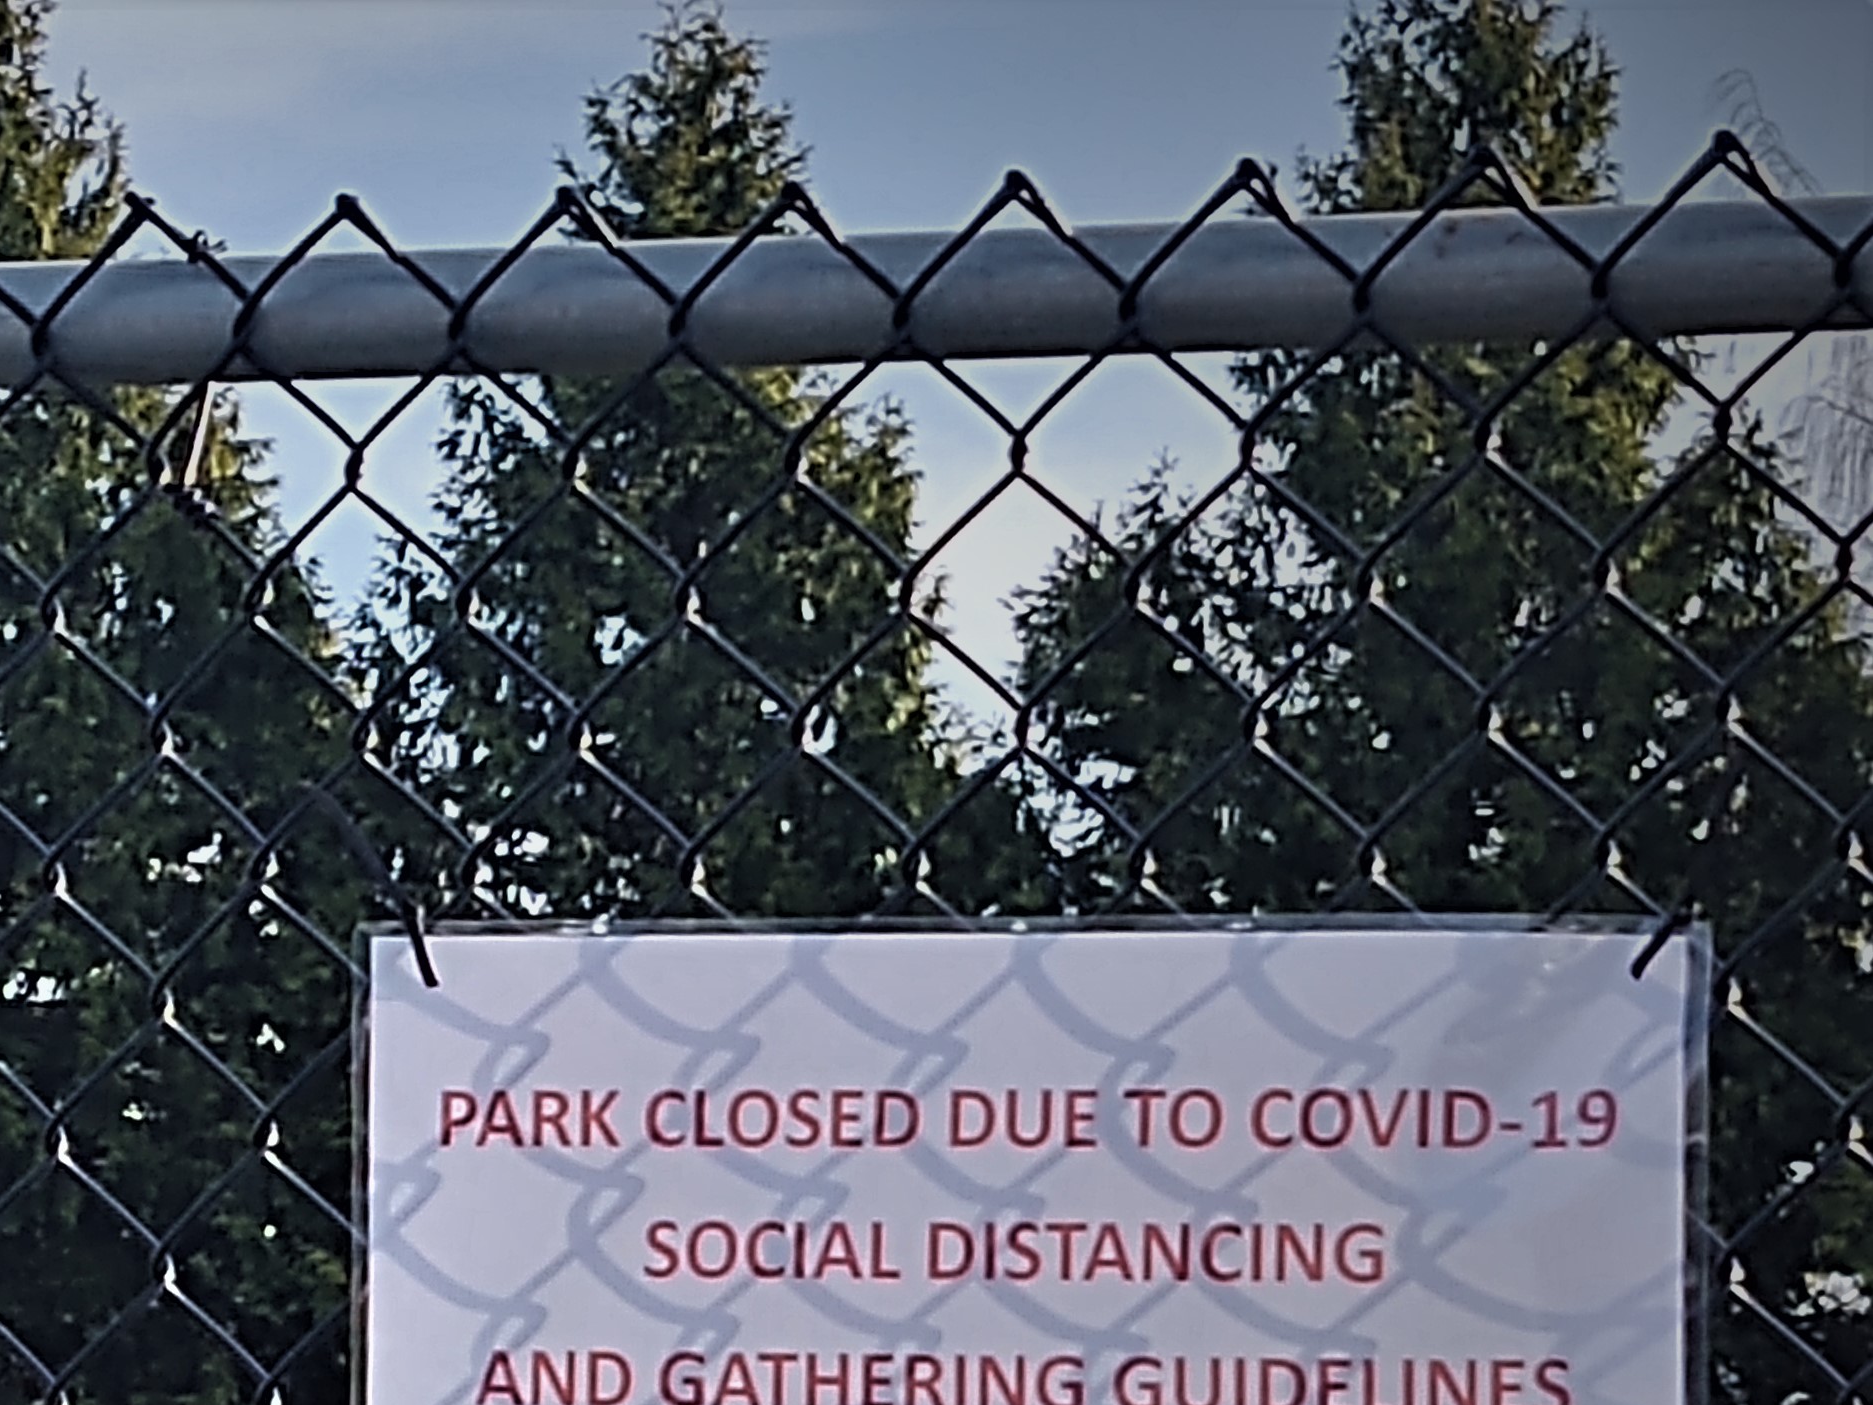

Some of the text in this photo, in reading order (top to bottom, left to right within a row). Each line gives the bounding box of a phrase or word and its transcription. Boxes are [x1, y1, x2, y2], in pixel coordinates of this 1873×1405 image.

[440, 1087, 1618, 1149] PARK CLOSED DUE TO COVID-19
[643, 1220, 1384, 1284] SOCIAL DISTANCING
